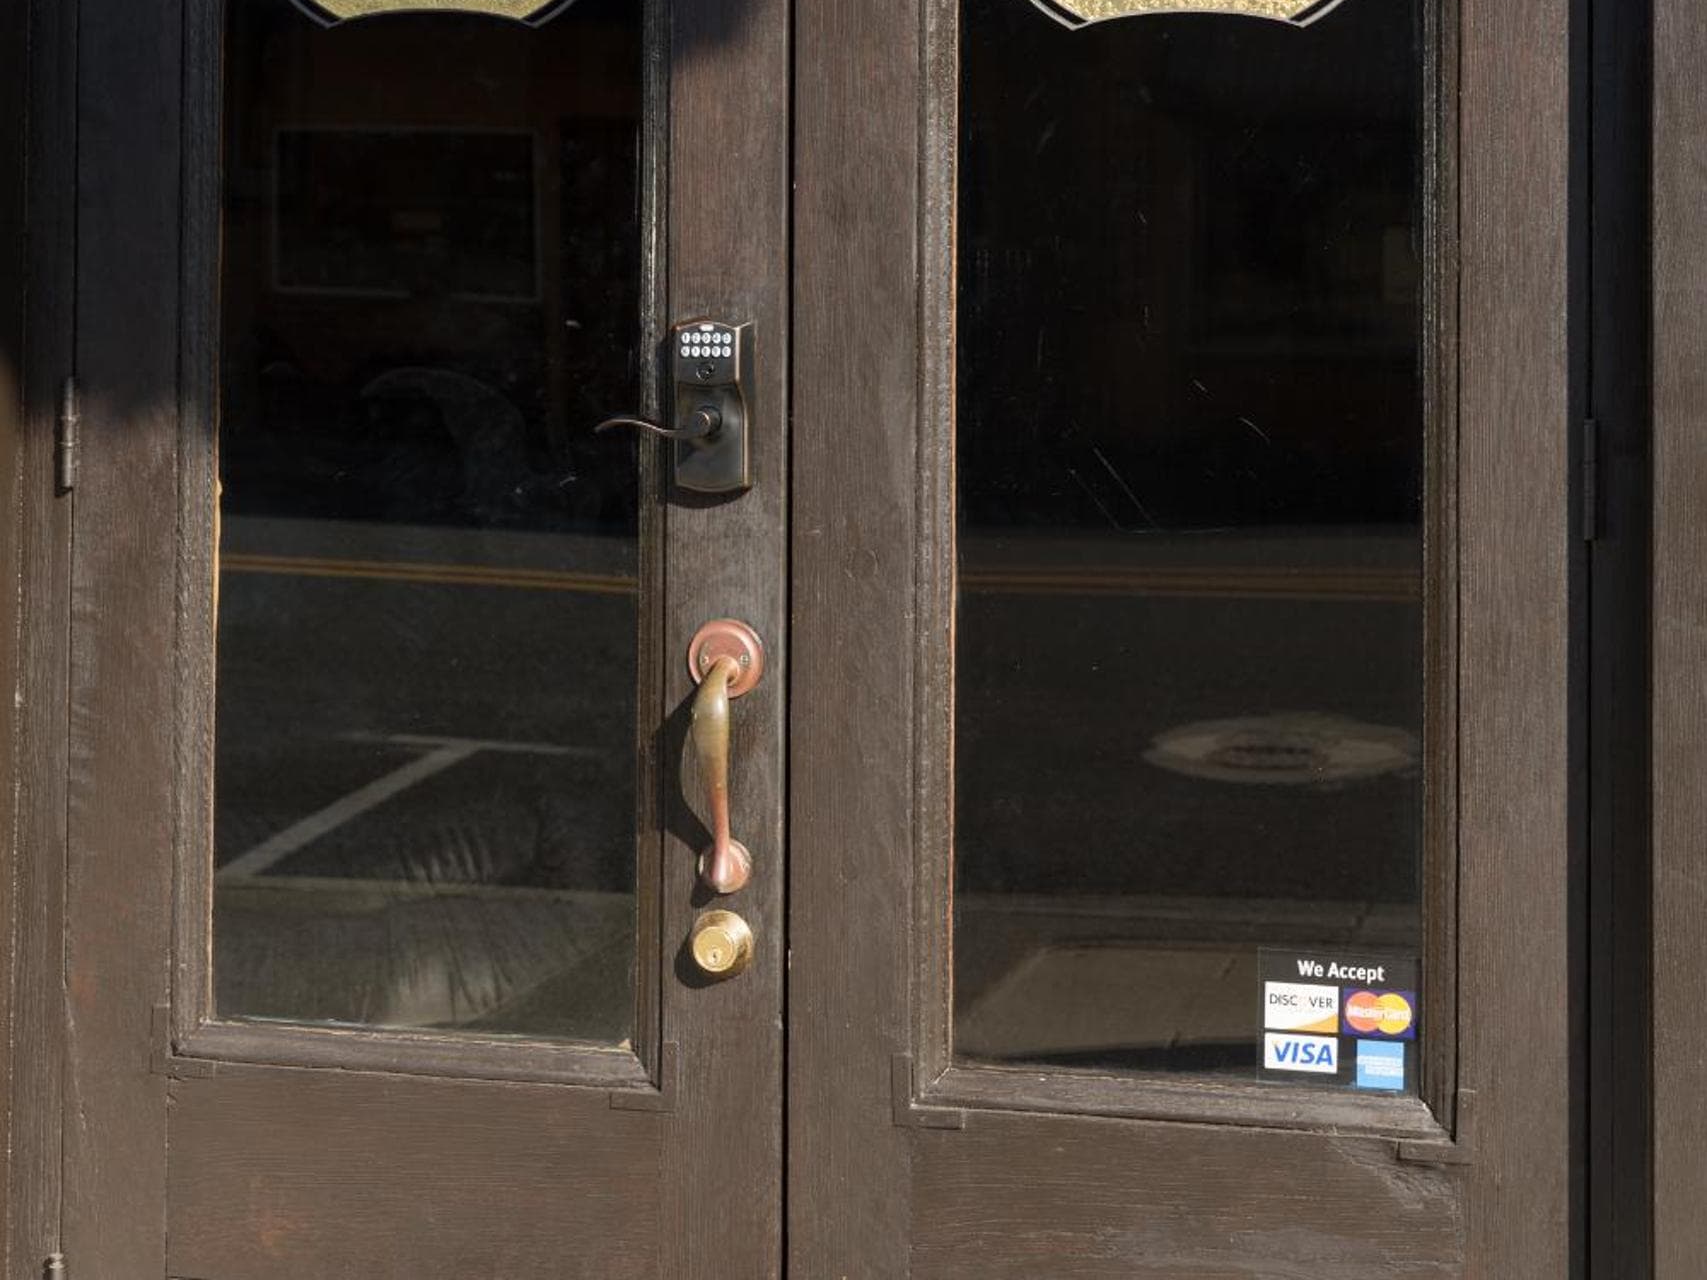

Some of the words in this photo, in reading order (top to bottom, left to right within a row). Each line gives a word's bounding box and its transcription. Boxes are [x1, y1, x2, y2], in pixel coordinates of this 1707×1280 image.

[1297, 959, 1324, 977] We
[1327, 962, 1385, 984] Accept
[1269, 993, 1333, 1009] DISCVER
[1273, 1041, 1333, 1066] VISA
